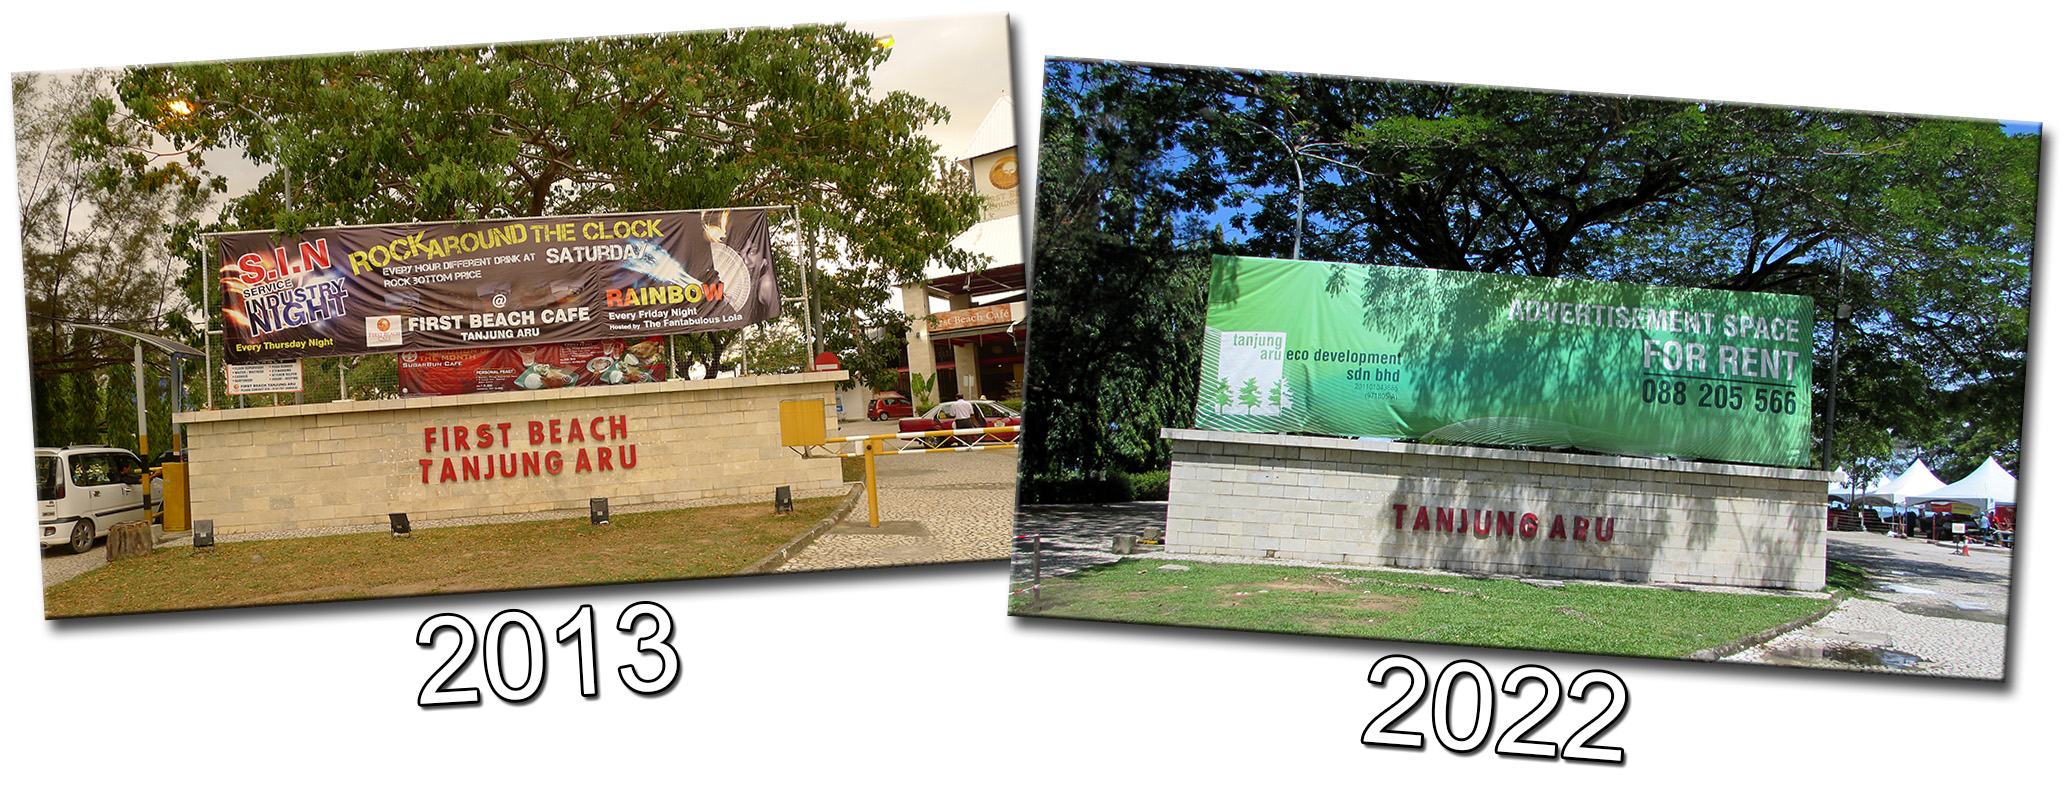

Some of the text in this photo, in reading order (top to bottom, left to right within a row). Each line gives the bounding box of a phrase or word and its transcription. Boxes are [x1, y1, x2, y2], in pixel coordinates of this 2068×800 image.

[348, 218, 665, 276] ROCK AROUND THE CLOCK
[382, 243, 648, 276] EVERY HOUR DIFFERENT DRINK AT SATURDAY
[238, 238, 332, 285] S.I.N
[243, 278, 293, 298] SERVICE
[383, 277, 411, 288] ROCK
[454, 270, 482, 281] PRICE
[245, 277, 348, 315] INDUSTRY
[492, 293, 507, 308] @
[605, 282, 724, 308] RAINBOW
[247, 296, 347, 337] NIGHT
[408, 306, 591, 331] FIRST BEACH CAFE
[608, 307, 698, 322] Every Friday Night
[643, 319, 661, 328] The
[663, 316, 720, 328] Fantabulous
[722, 313, 743, 322] Lola
[954, 313, 983, 324] Beach
[985, 309, 1010, 321] Café
[1507, 299, 1799, 342] ADVERTISEMENT SPACE
[236, 337, 334, 352] Every Thursday Night
[461, 327, 540, 341] TANJUNG ARU
[1233, 333, 1282, 349] tanjung
[1260, 349, 1401, 366] aru eco development
[1643, 339, 1799, 381] FOR RENT
[1347, 367, 1400, 382] sdn bhd
[1642, 379, 1797, 415] 088 205 566
[424, 415, 627, 452] FIRST BEACH
[419, 444, 637, 483] TANJUNG ARU
[1393, 504, 1615, 541] TANJUNG ARU
